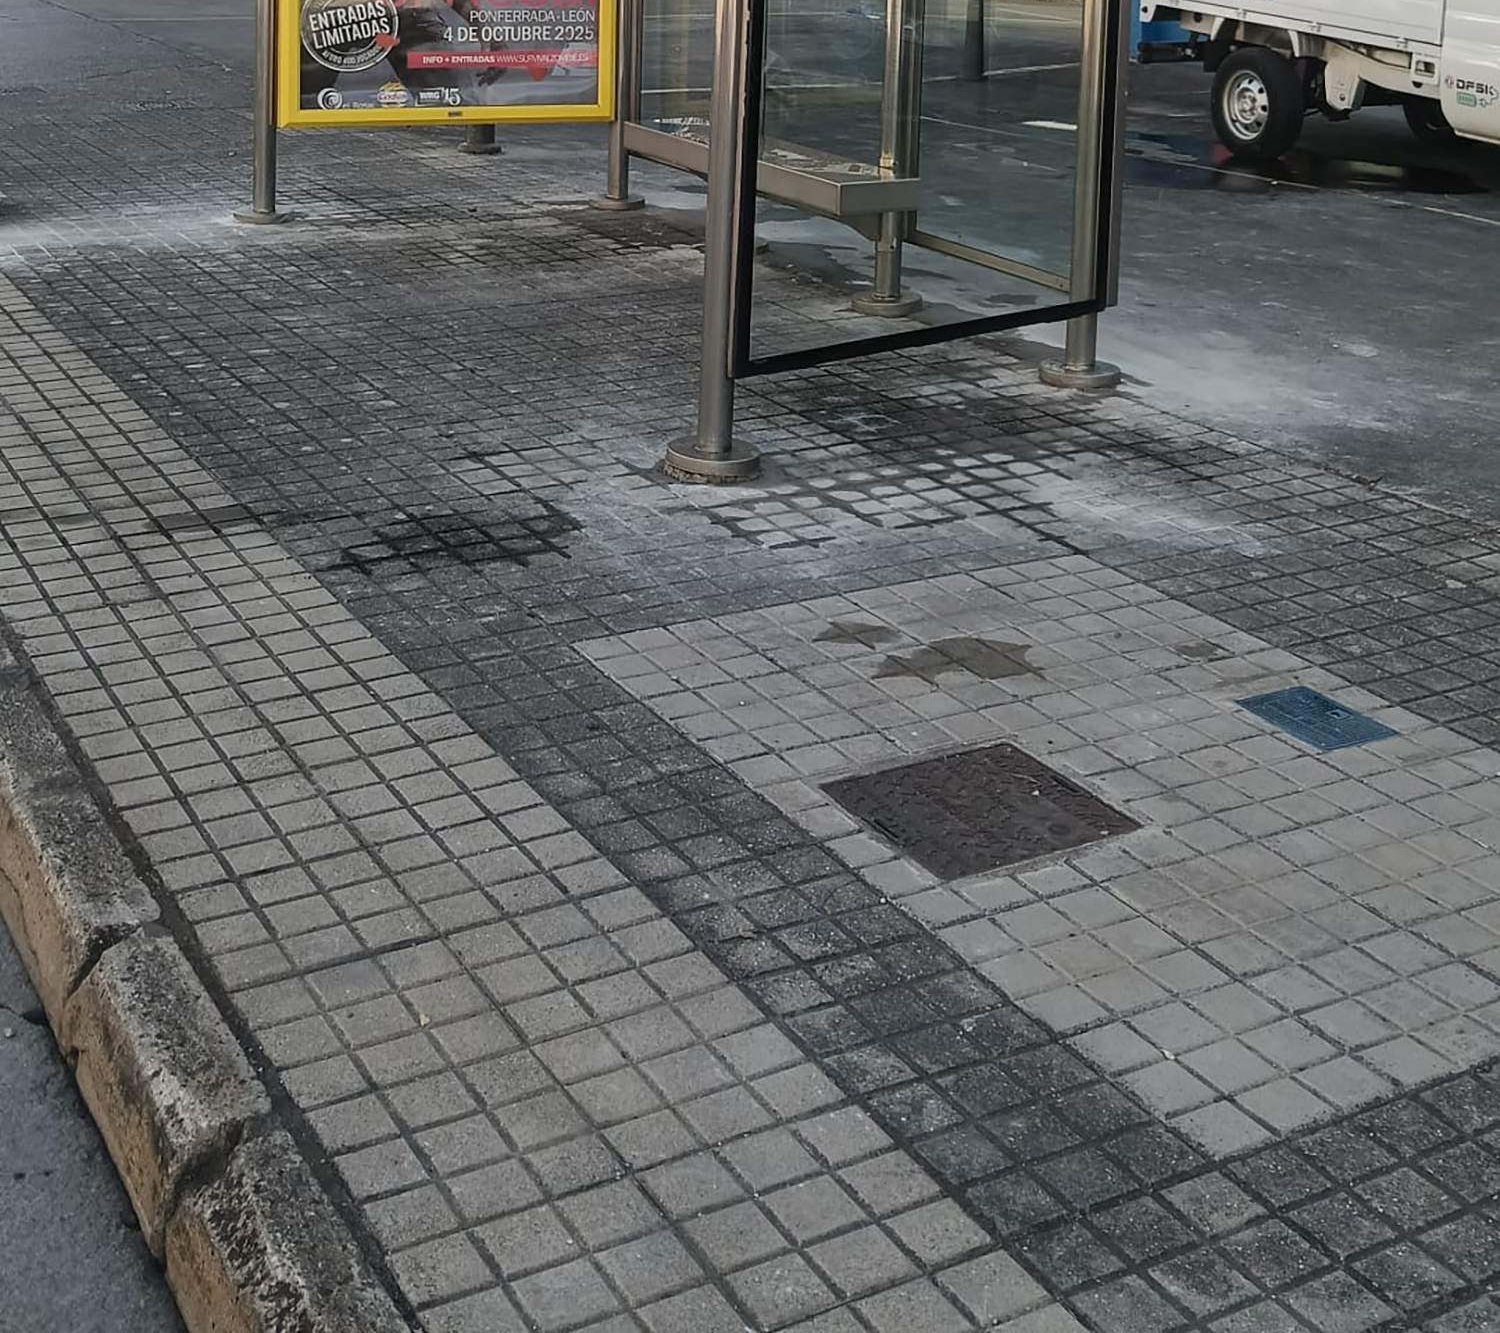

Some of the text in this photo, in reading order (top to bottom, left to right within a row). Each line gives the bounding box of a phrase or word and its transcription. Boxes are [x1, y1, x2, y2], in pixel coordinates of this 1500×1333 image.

[309, 0, 386, 32] ENTRADAS
[312, 17, 391, 50] LIMITADAS
[443, 25, 595, 42] 4 DE OCTUBRE 2025
[423, 55, 443, 64] INFO
[451, 54, 495, 64] ENTRADAS
